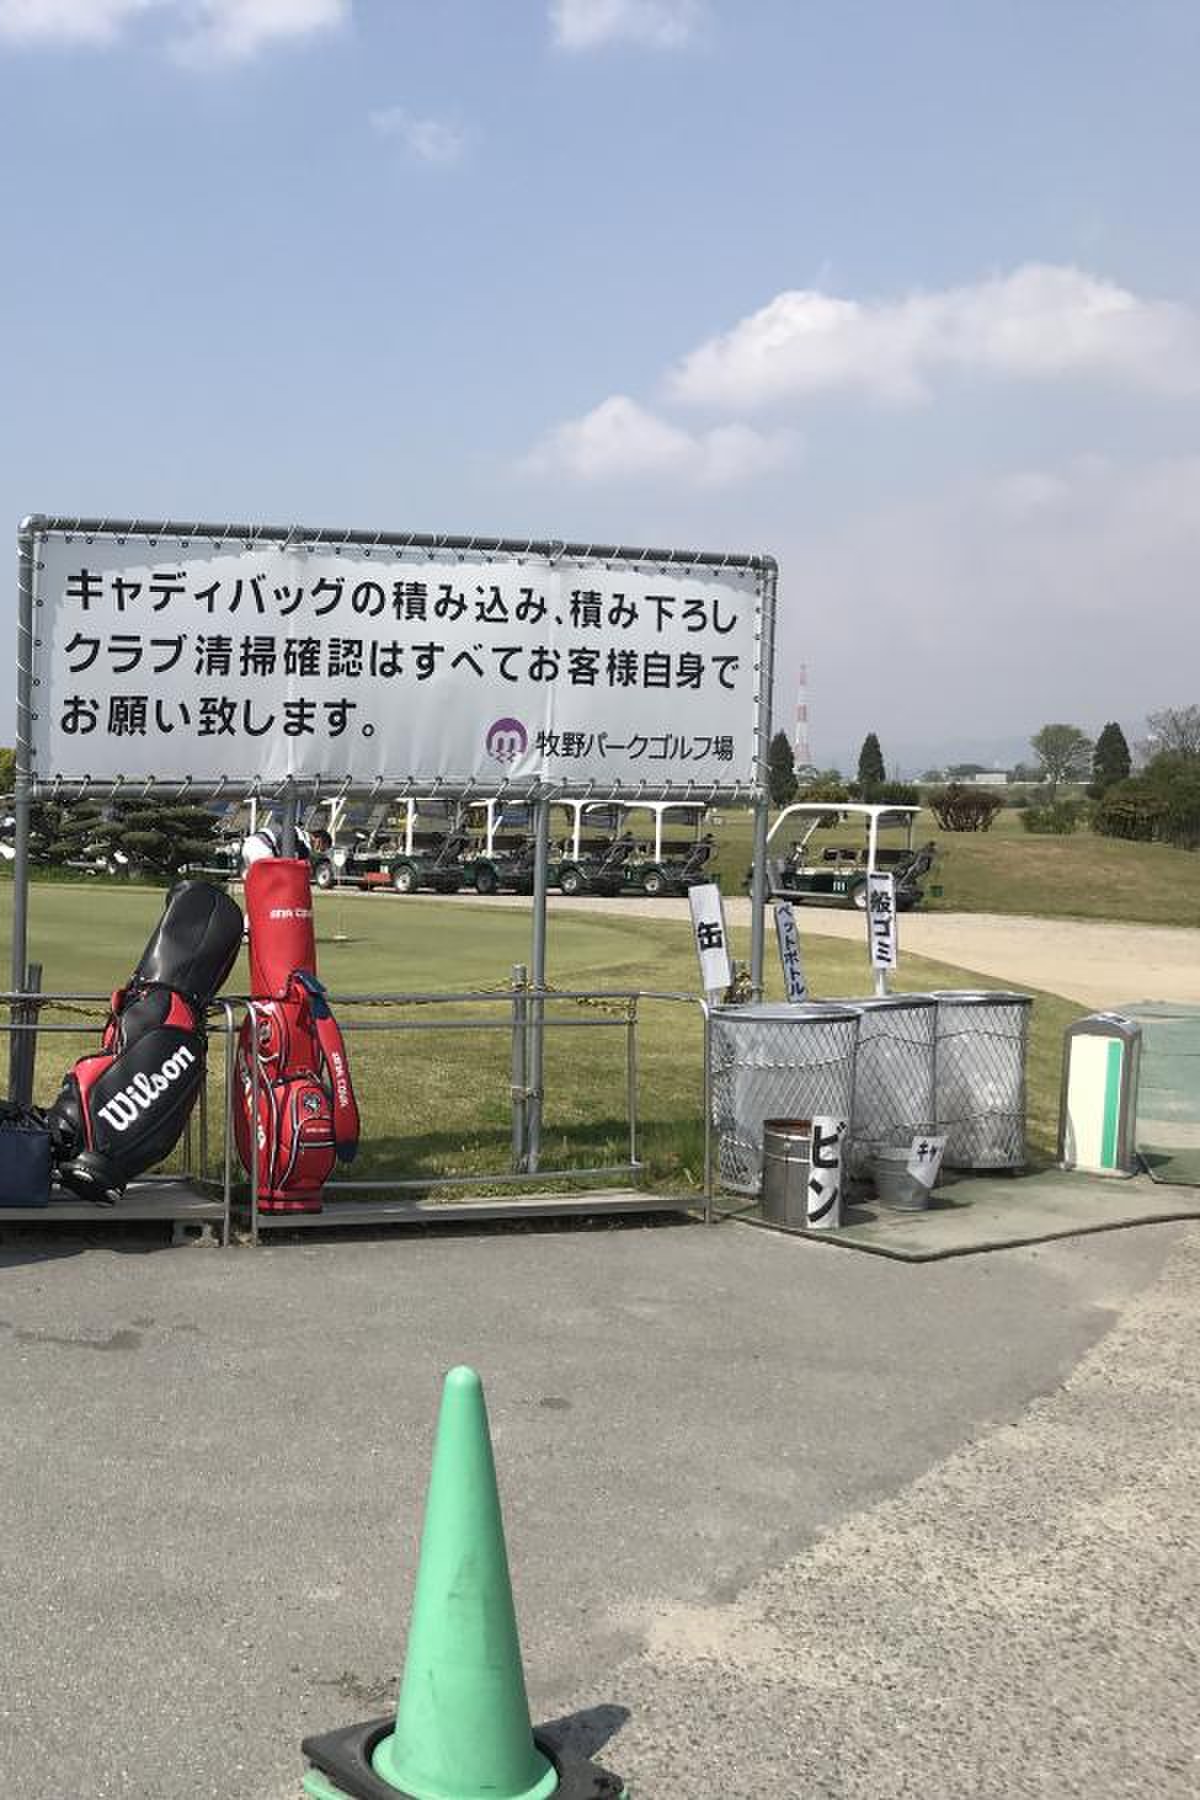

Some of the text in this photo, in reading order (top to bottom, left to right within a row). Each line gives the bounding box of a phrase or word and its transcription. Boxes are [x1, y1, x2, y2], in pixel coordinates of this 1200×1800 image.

[63, 632, 739, 689] クラブ清掃確認はすべてお客様自身で
[60, 695, 376, 738] お願い致します。
[535, 730, 734, 762] 牧野パークゴルフ場
[697, 921, 723, 951] 缶
[777, 903, 806, 996] ペットボトル
[97, 1045, 196, 1131] Wilson
[807, 1120, 847, 1223] ビン
